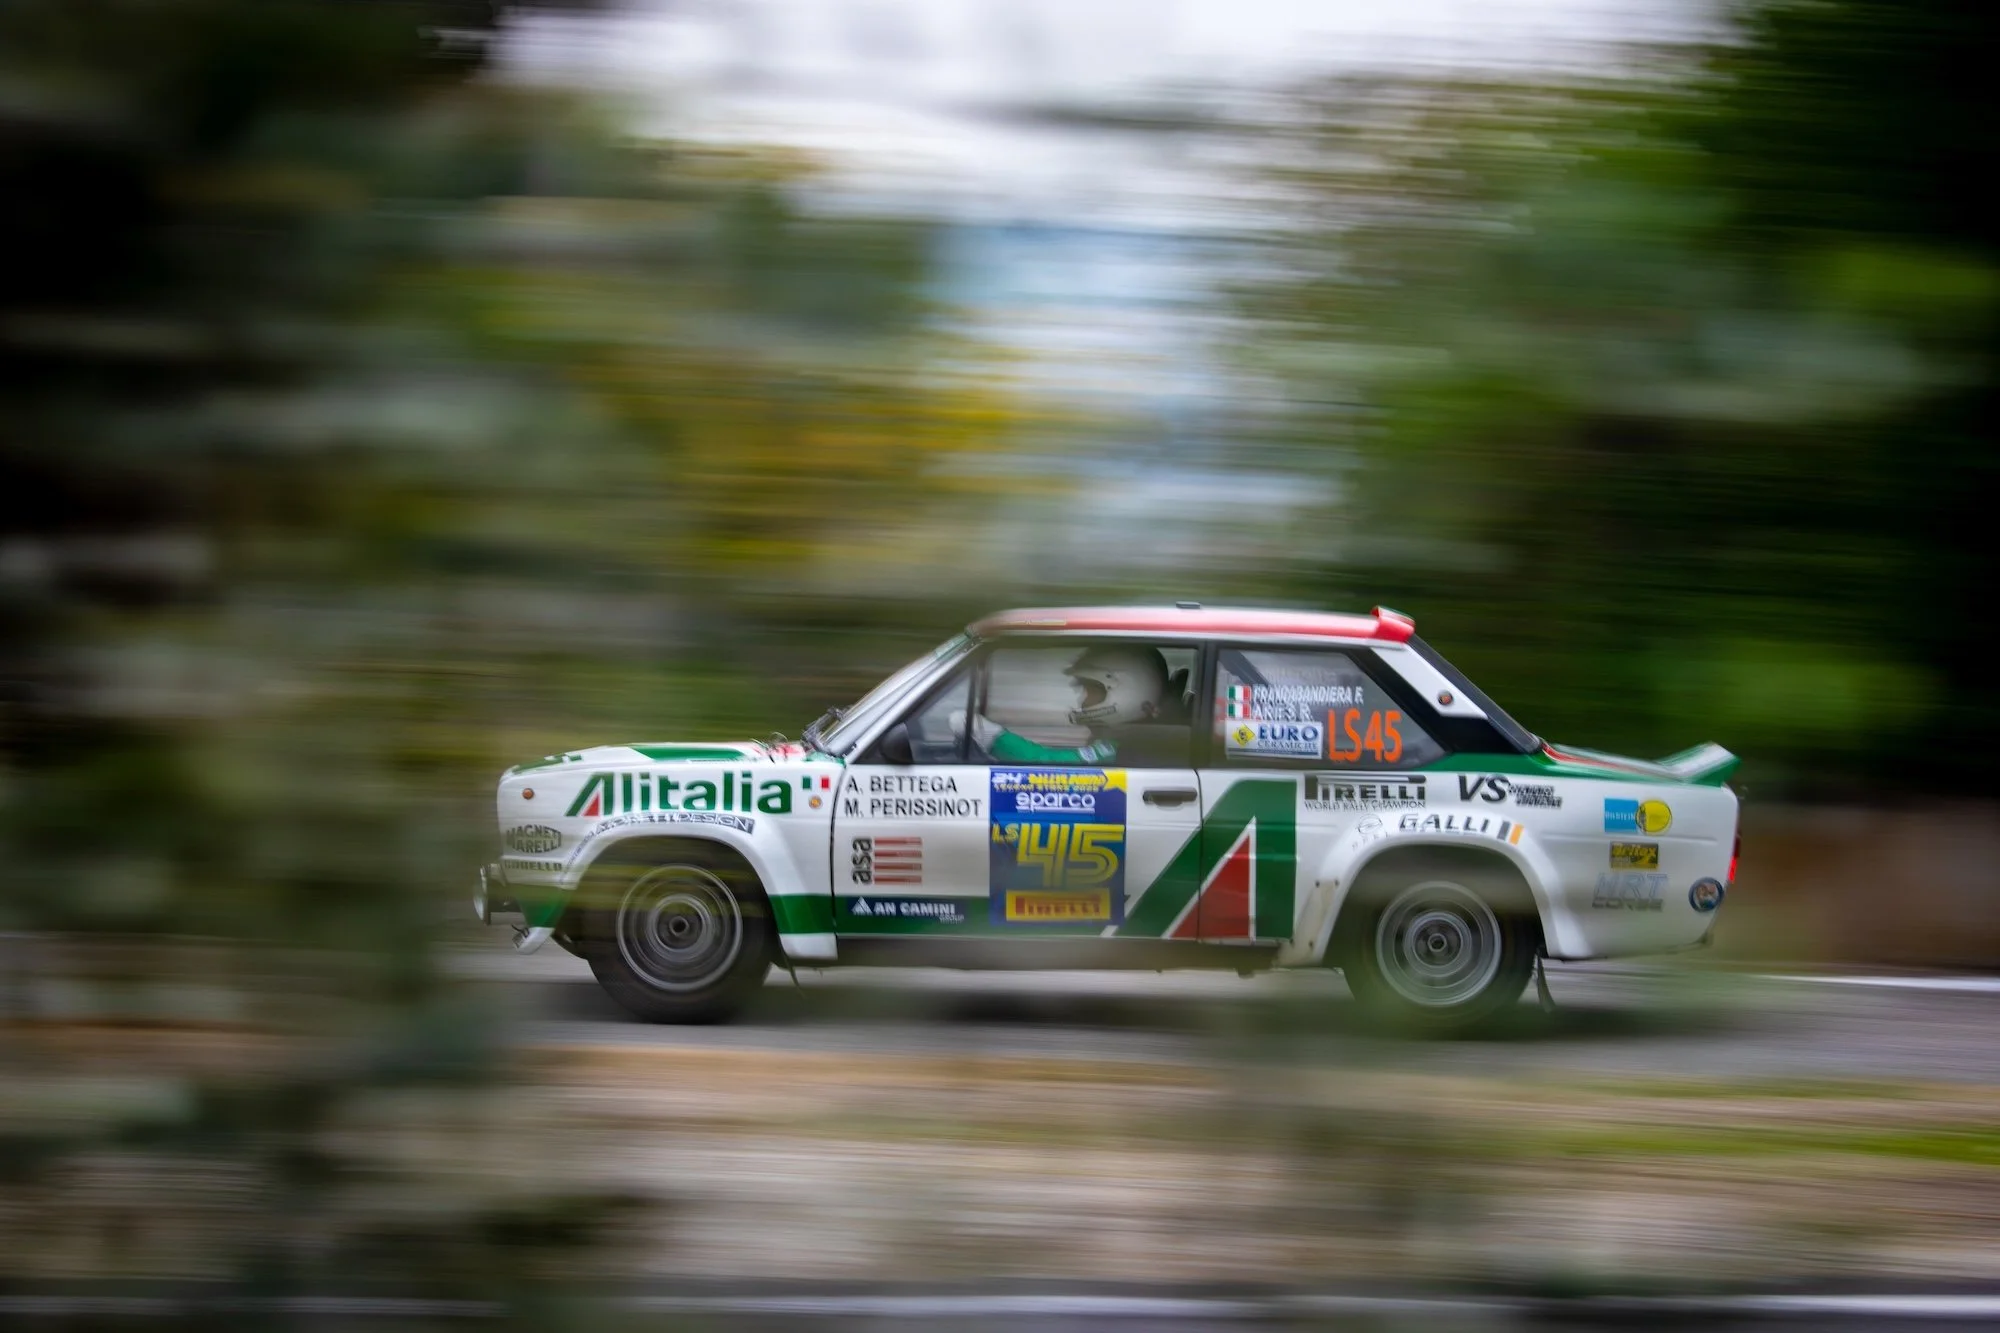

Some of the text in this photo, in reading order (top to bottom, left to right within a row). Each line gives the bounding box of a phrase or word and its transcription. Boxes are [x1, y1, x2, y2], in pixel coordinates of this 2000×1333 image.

[1259, 724, 1319, 741] EURO
[1328, 709, 1403, 763] LS45
[565, 771, 792, 817] Alitalia
[846, 776, 958, 793] A. BETTEGA
[1304, 773, 1426, 801] PIRELLI
[1458, 773, 1512, 804] VS
[844, 798, 982, 818] M. PERISSINOT
[1016, 792, 1096, 812] sparco
[1304, 799, 1427, 811] WORLD RALLY CHAMPION
[676, 812, 755, 834] DESIGN
[1400, 813, 1491, 833] GALLI
[852, 838, 873, 884] asa
[992, 823, 1125, 887] LS 45
[874, 902, 955, 917] AN CAMINI
